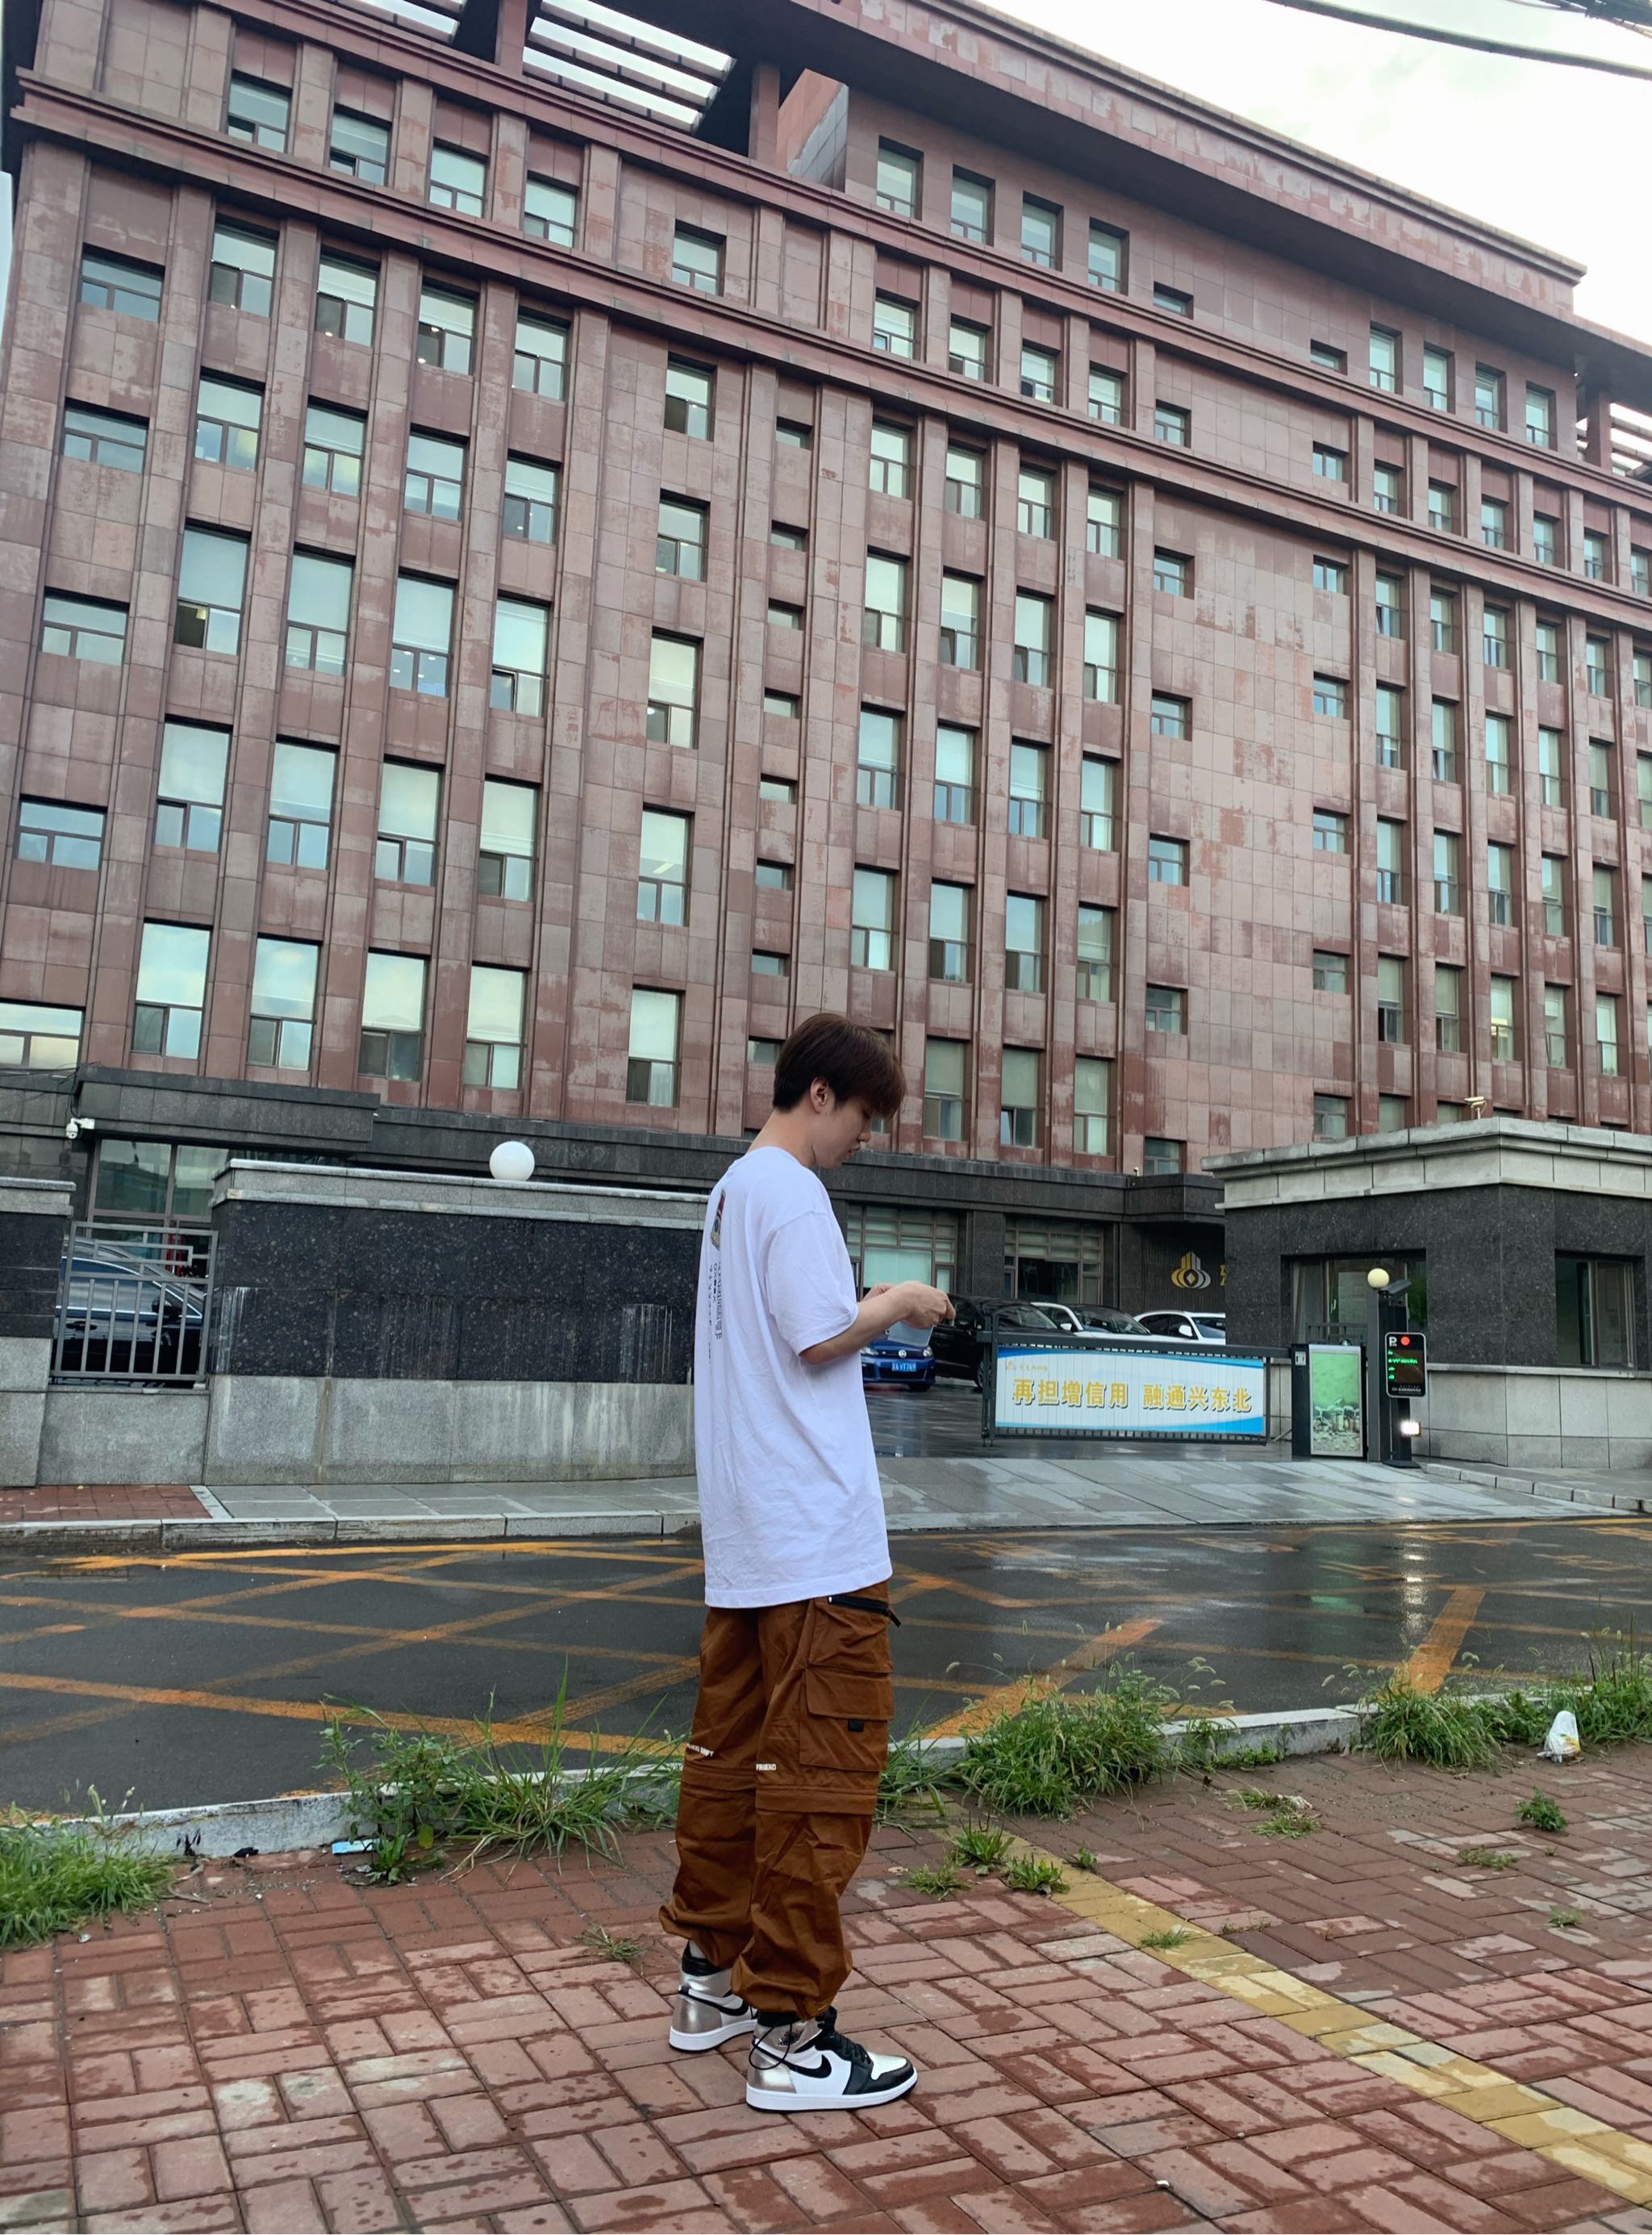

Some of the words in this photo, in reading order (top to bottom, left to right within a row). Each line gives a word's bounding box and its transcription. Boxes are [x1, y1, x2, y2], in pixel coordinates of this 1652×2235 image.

[1013, 1377, 1128, 1409] 再担增信用
[1142, 1383, 1252, 1413] 融通兴东北
